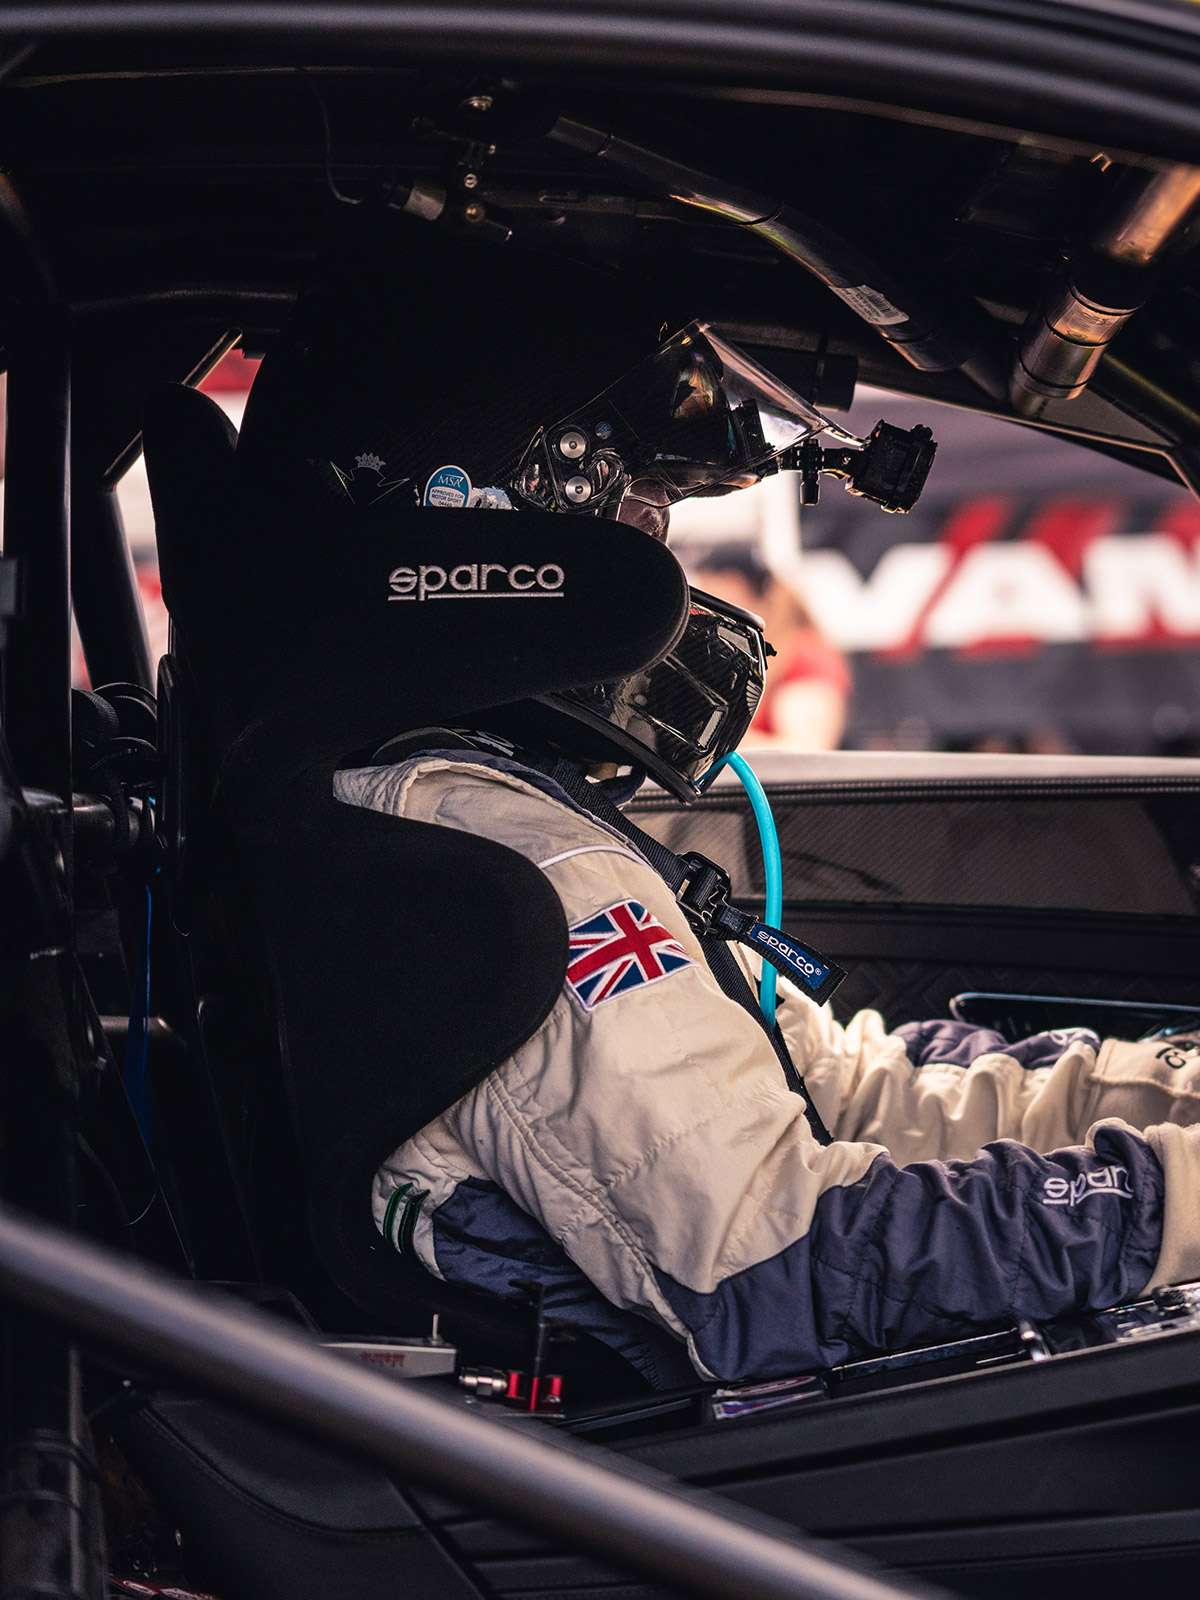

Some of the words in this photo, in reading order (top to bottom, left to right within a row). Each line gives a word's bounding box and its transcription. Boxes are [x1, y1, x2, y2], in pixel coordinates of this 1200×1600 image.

[431, 488, 455, 498] APPROVED
[437, 475, 462, 488] MSA
[387, 563, 565, 601] sparco
[1043, 1163, 1134, 1207] spar
